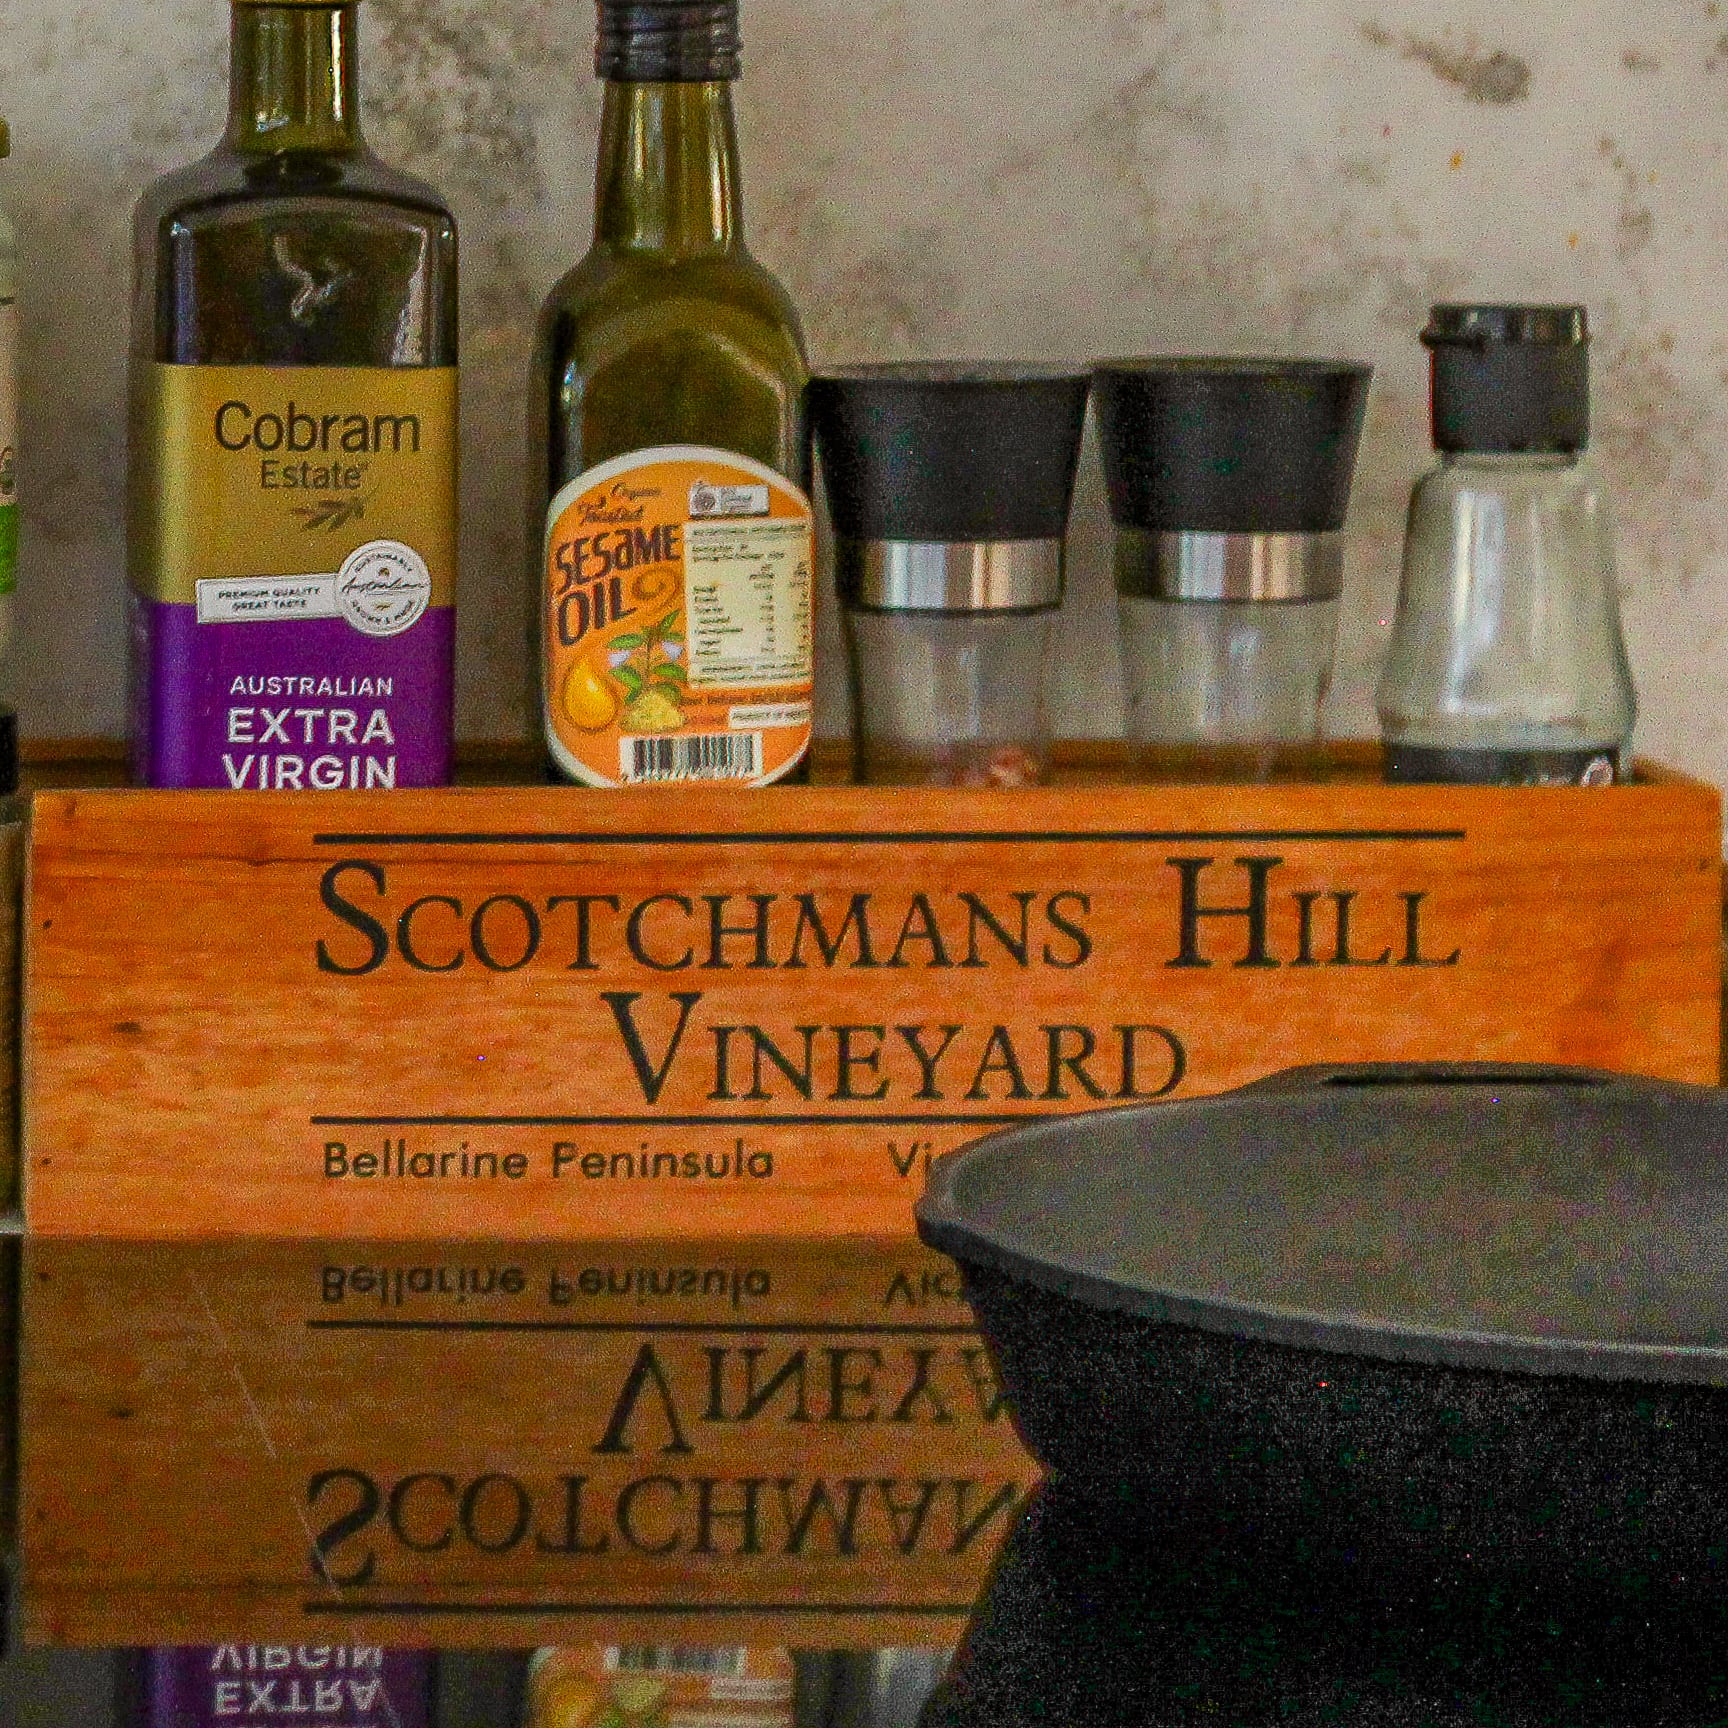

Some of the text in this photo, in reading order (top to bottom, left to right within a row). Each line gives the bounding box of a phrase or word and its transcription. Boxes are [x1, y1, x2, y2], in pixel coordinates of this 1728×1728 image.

[215, 400, 421, 453] Cobram
[260, 459, 362, 490] Estate
[218, 585, 321, 600] PREMIUM QUALITY
[557, 577, 638, 647] OIL
[229, 675, 394, 697] AUSTRALIAN
[227, 707, 395, 745] EXTRA
[222, 752, 397, 790] VIRGIN
[314, 856, 1462, 976] SCOTCHMANS HILL
[600, 991, 1189, 1105] VINEYARD
[324, 1141, 528, 1180] Bellarine
[551, 1141, 774, 1180] Peninsula
